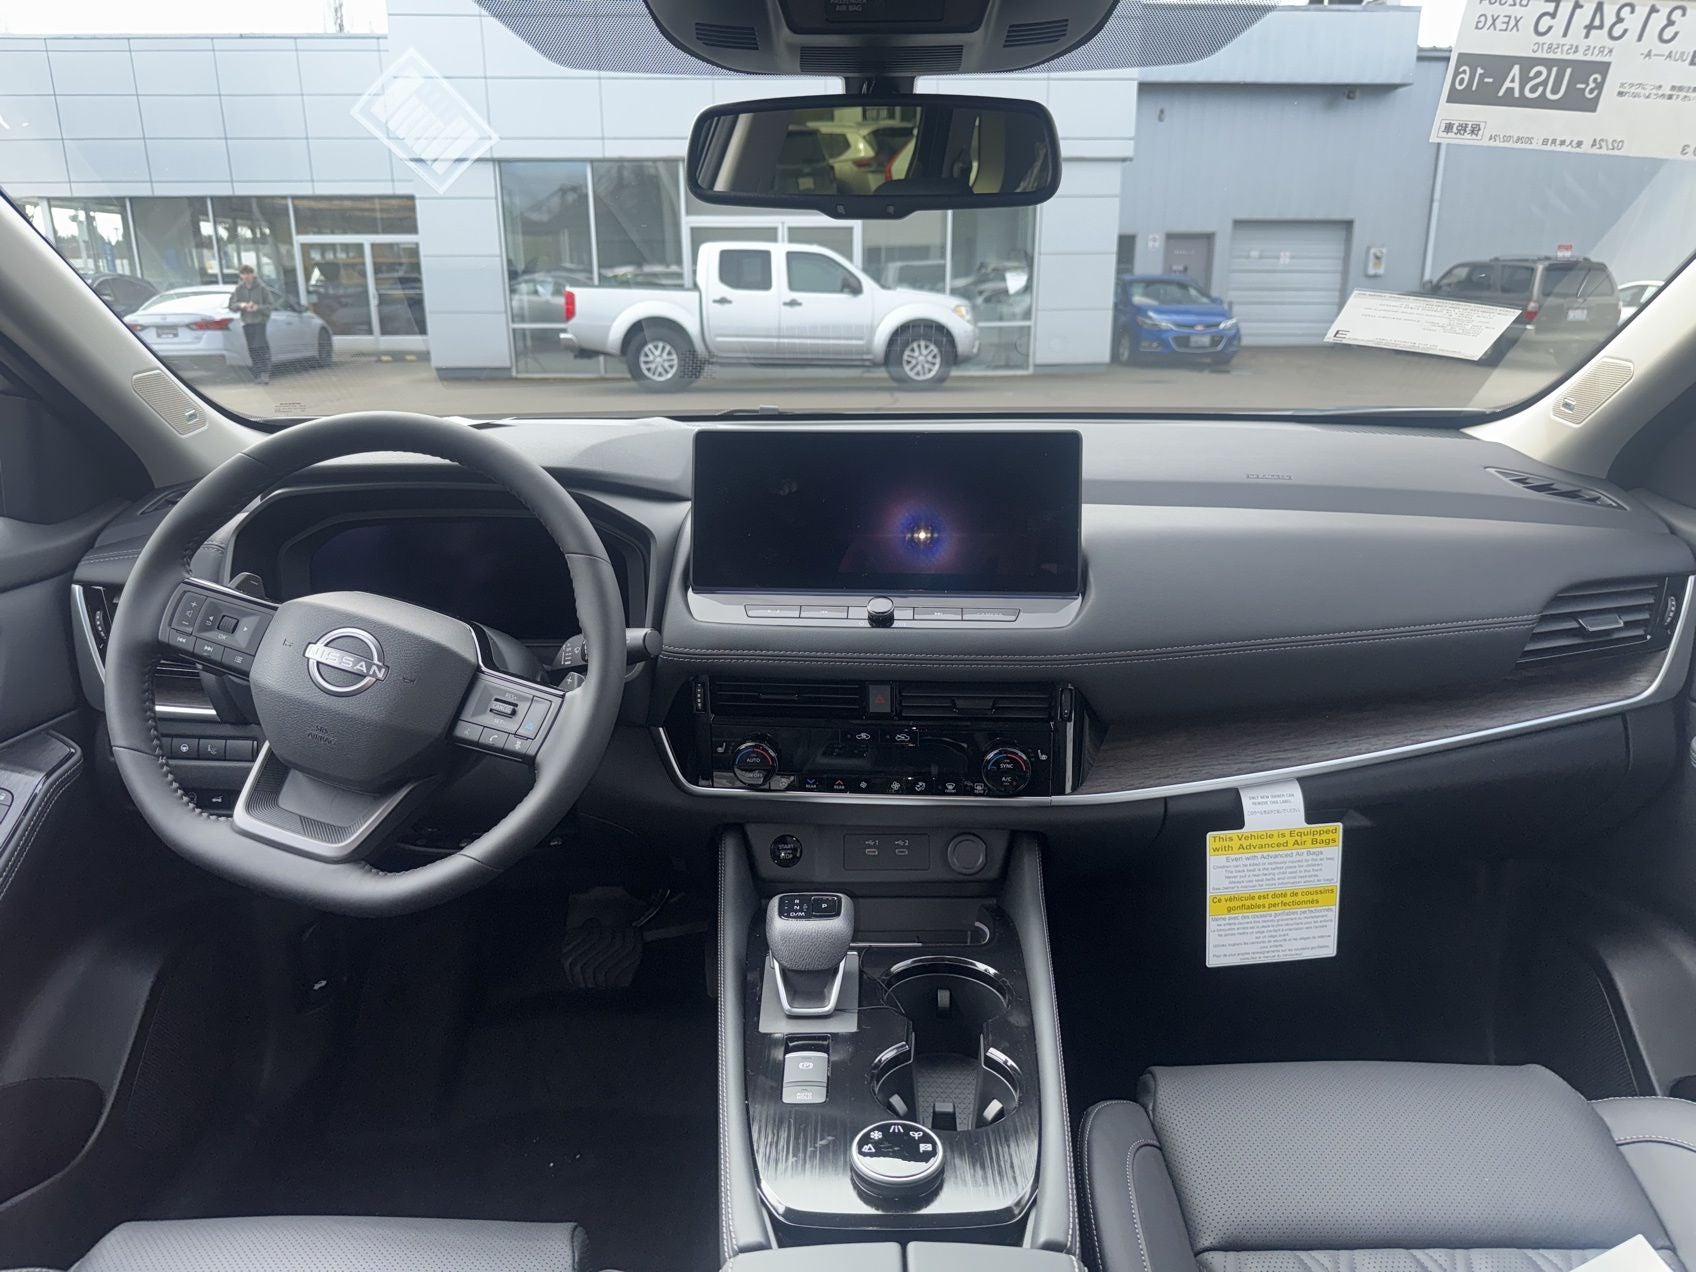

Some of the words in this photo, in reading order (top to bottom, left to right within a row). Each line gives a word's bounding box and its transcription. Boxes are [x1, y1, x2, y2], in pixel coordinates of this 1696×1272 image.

[307, 645, 386, 679] NISSAN
[1212, 835, 1233, 843] This
[1236, 832, 1274, 841] Vehicle
[1289, 827, 1336, 838] Equipped
[1212, 844, 1233, 852] with
[1237, 840, 1288, 850] Advanced
[1292, 838, 1306, 846] Air
[1311, 836, 1336, 845] Bags
[1260, 851, 1293, 859] Advanced
[1225, 893, 1255, 902] véhicule
[1301, 887, 1334, 896] coussins
[1226, 902, 1266, 912] gonflables
[1267, 898, 1319, 909] perfectionnés
